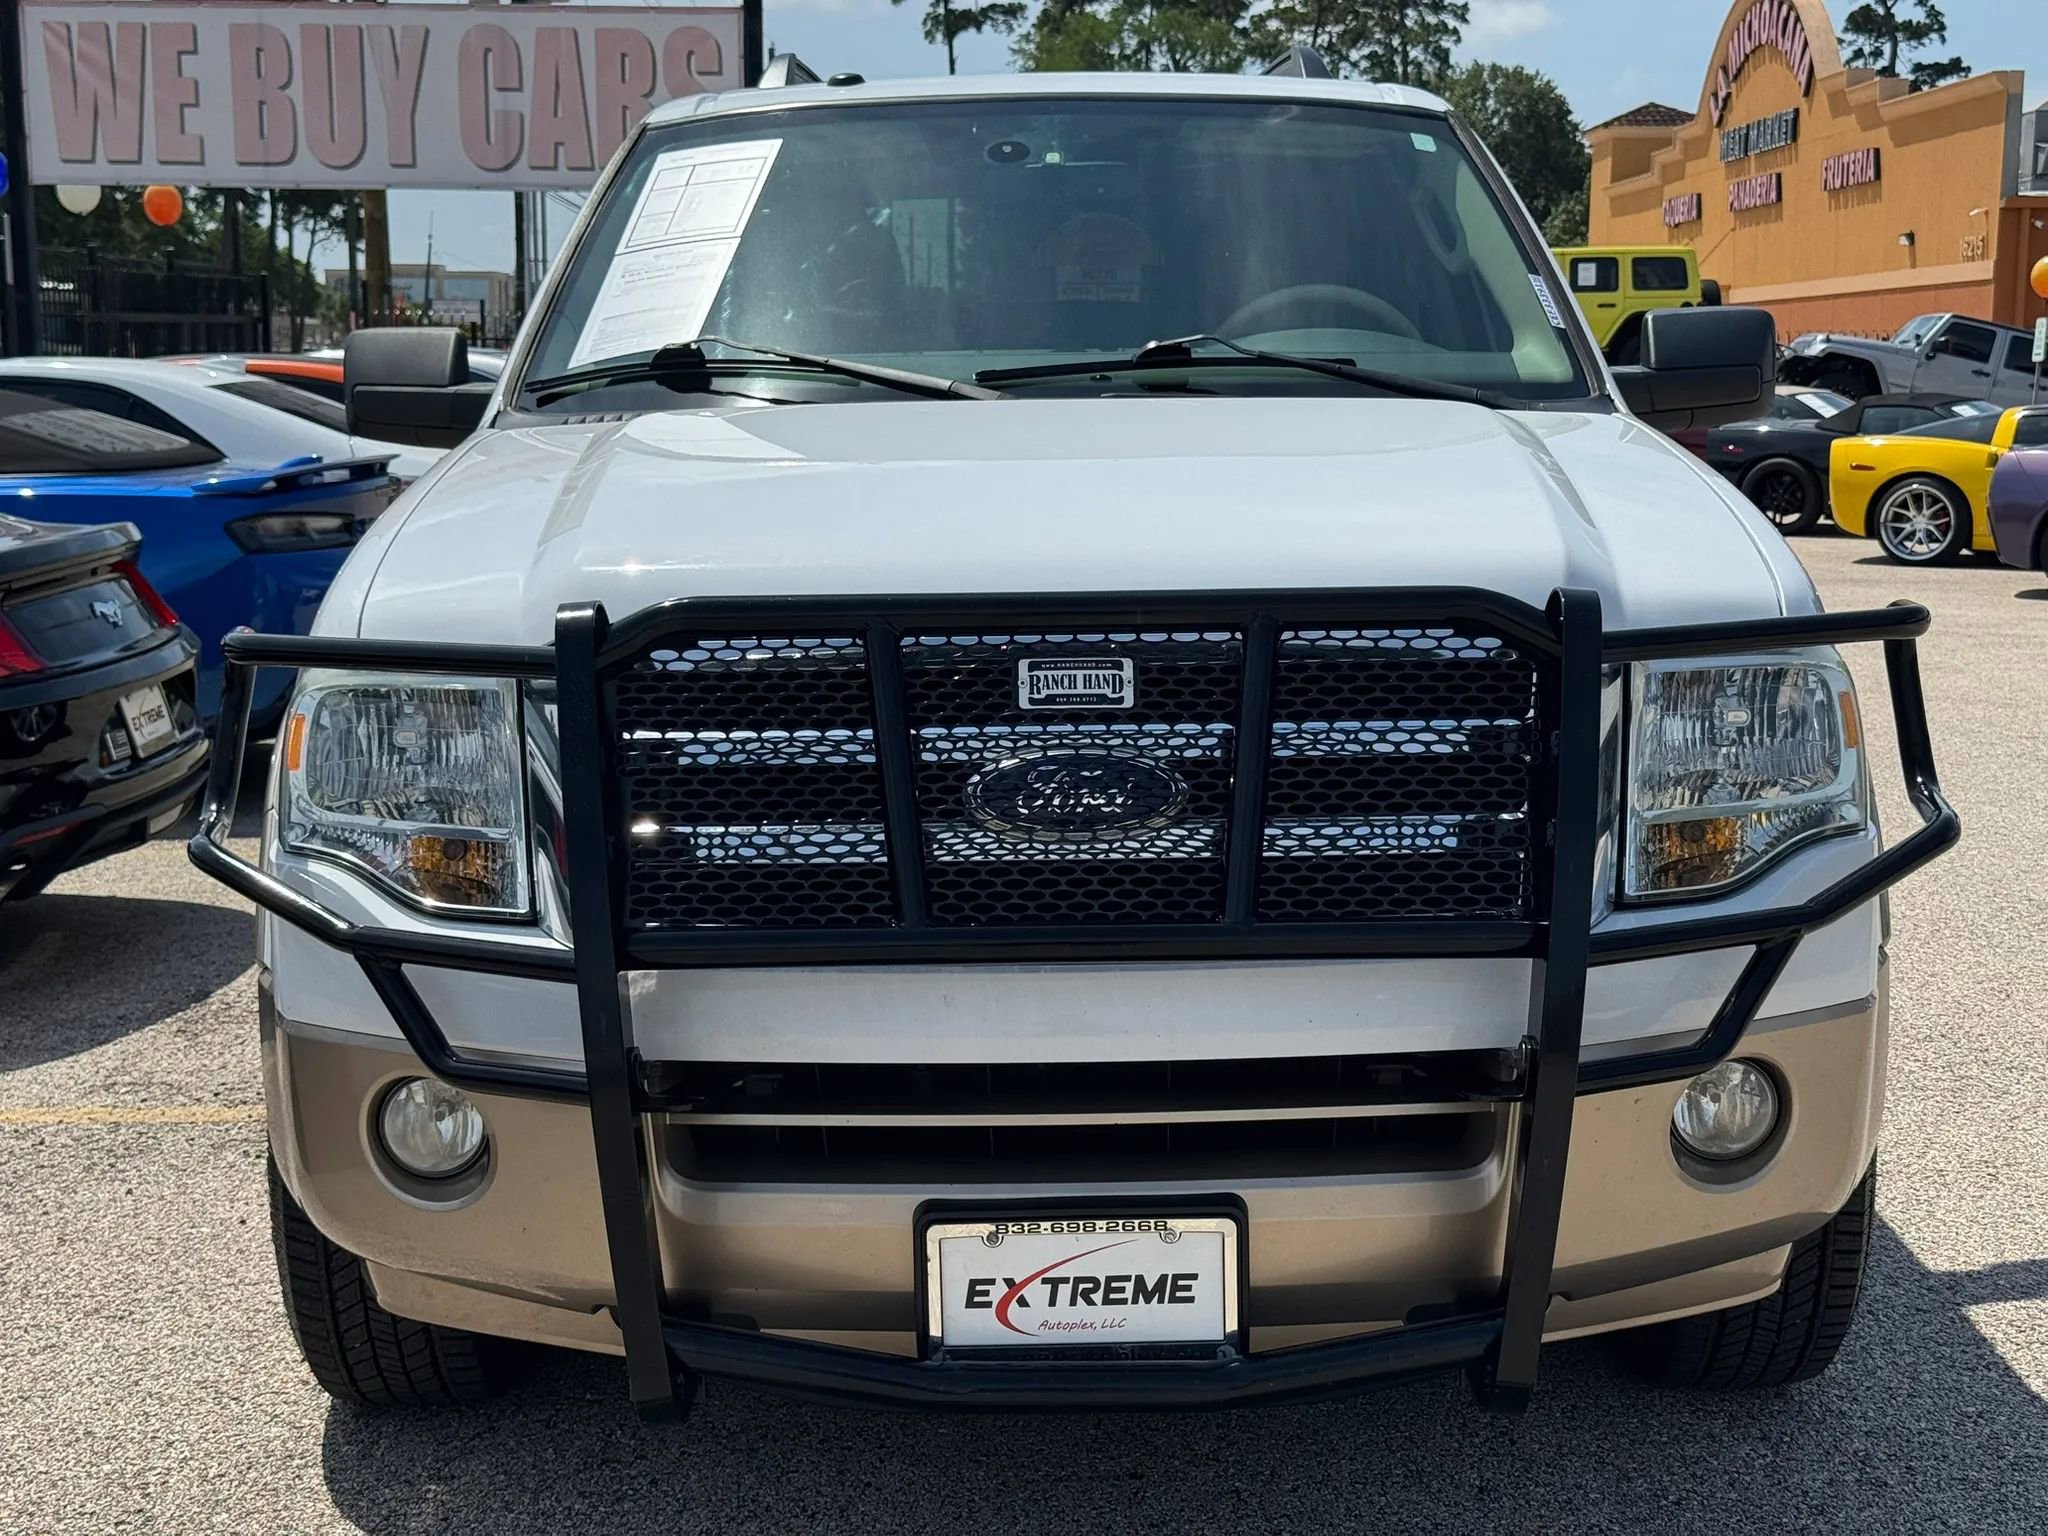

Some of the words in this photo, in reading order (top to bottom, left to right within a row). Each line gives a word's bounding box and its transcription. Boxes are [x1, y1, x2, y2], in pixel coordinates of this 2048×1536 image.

[1709, 66, 1730, 127] LA
[1728, 0, 1813, 98] MICHOACANA
[42, 22, 205, 167] WE
[229, 24, 430, 170] BUY
[1720, 124, 1748, 162] MEAT
[1747, 108, 1798, 156] MARKET
[1821, 148, 1879, 192] FRUTERIA
[1728, 173, 1781, 212] PANADERIA
[1029, 674, 1077, 695] RANCH
[1083, 673, 1124, 694] HAND
[995, 1220, 1168, 1234] 832-698-2668
[965, 1273, 1199, 1309] EXTREME
[1038, 1318, 1097, 1332] Autoplex,
[1101, 1318, 1127, 1329] LLC
